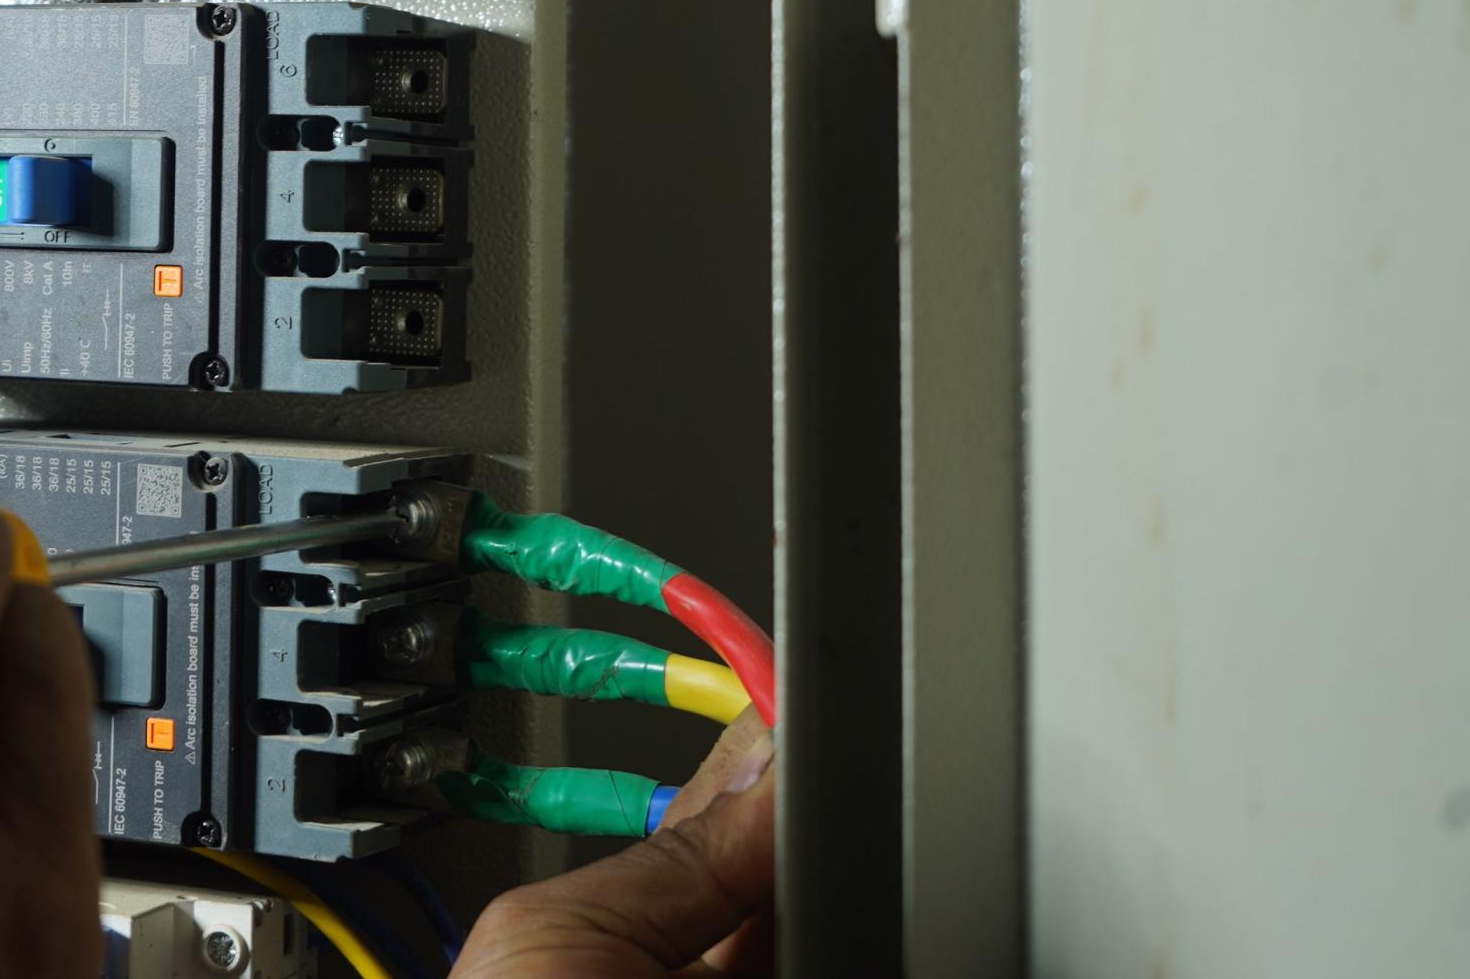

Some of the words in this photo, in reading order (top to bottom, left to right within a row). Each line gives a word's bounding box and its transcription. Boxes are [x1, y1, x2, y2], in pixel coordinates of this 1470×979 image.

[267, 11, 279, 60] LOAD
[280, 65, 296, 78] 6
[196, 77, 207, 124] installed
[196, 127, 206, 143] be
[197, 147, 207, 174] must
[195, 179, 206, 212] board
[279, 190, 294, 204] 4
[44, 230, 71, 243] OFF
[195, 216, 205, 265] isolation
[5, 260, 14, 292] 800V
[24, 260, 33, 284] 8kV
[44, 261, 53, 270] A
[194, 269, 205, 289] Arc
[43, 274, 52, 295] Cat
[163, 303, 172, 327] TRIP
[275, 317, 291, 329] 2
[42, 308, 52, 374] 50Hz/60Hz
[126, 313, 135, 356] 60947-2
[163, 330, 172, 346] TO
[3, 360, 12, 372] Ui
[22, 342, 32, 373] Uimp
[125, 359, 134, 378] IEC
[163, 349, 172, 380] PUSH
[15, 455, 26, 488] 36/18
[32, 456, 42, 490] 36/18
[49, 458, 60, 491] 36/18
[66, 459, 77, 492] 25/15
[83, 460, 94, 494] 25/15
[101, 461, 111, 495] 25/15
[259, 463, 273, 514] LOAD
[188, 579, 199, 600] be
[189, 603, 199, 632] must
[187, 635, 198, 671] board
[272, 649, 288, 663] 4
[186, 674, 198, 725] isolation
[186, 728, 197, 750] Arc
[154, 760, 164, 786] TRIP
[268, 778, 285, 792] 2
[115, 768, 126, 812] 60947-2
[154, 789, 164, 807] TO
[115, 814, 126, 836] IEC
[154, 810, 164, 839] PUSH
